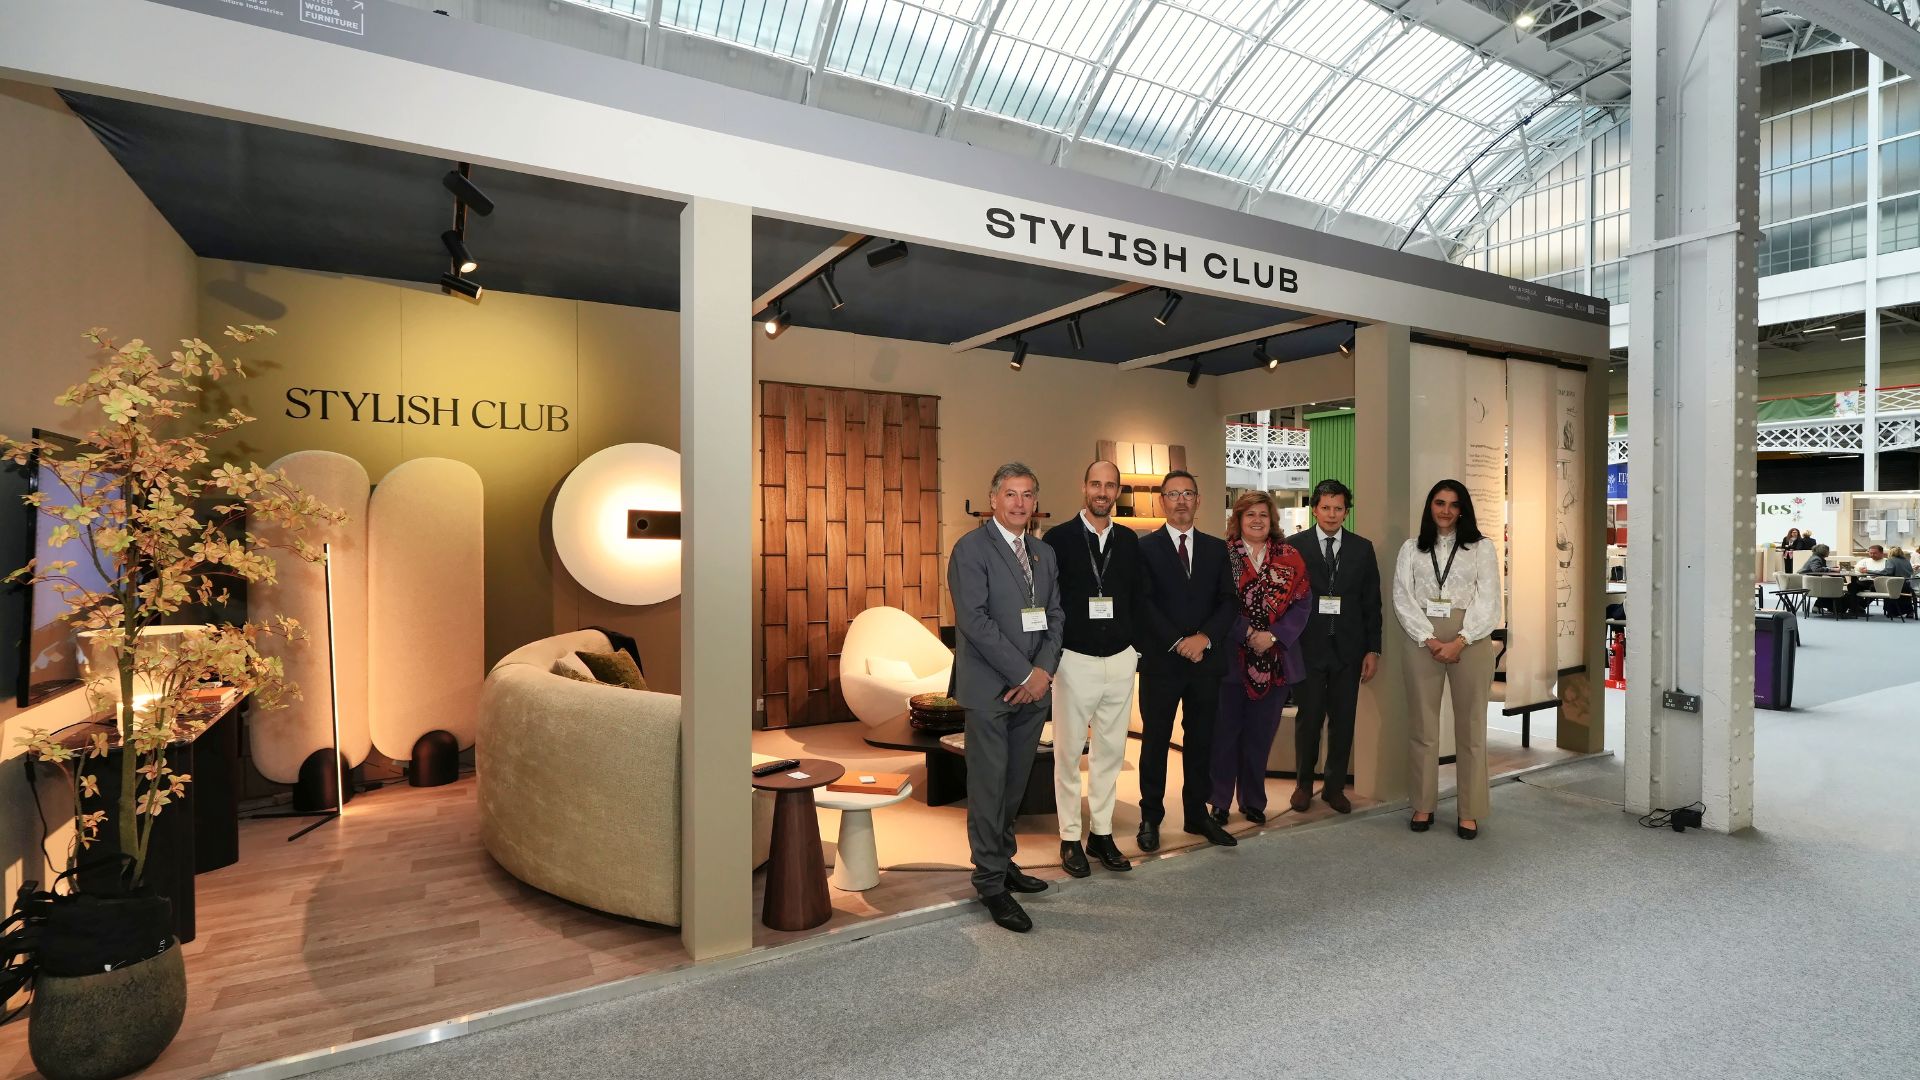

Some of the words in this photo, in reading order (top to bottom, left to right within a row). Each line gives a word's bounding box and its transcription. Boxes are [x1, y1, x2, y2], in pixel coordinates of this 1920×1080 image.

[246, 3, 284, 16] Industries
[305, 1, 340, 16] WOOD&
[305, 11, 359, 30] FURNITURE
[986, 208, 1187, 272] STYLISH
[1203, 252, 1299, 294] CLUB
[285, 387, 460, 427] STYLISH
[471, 400, 570, 432] CLUB
[1757, 501, 1792, 515] les
